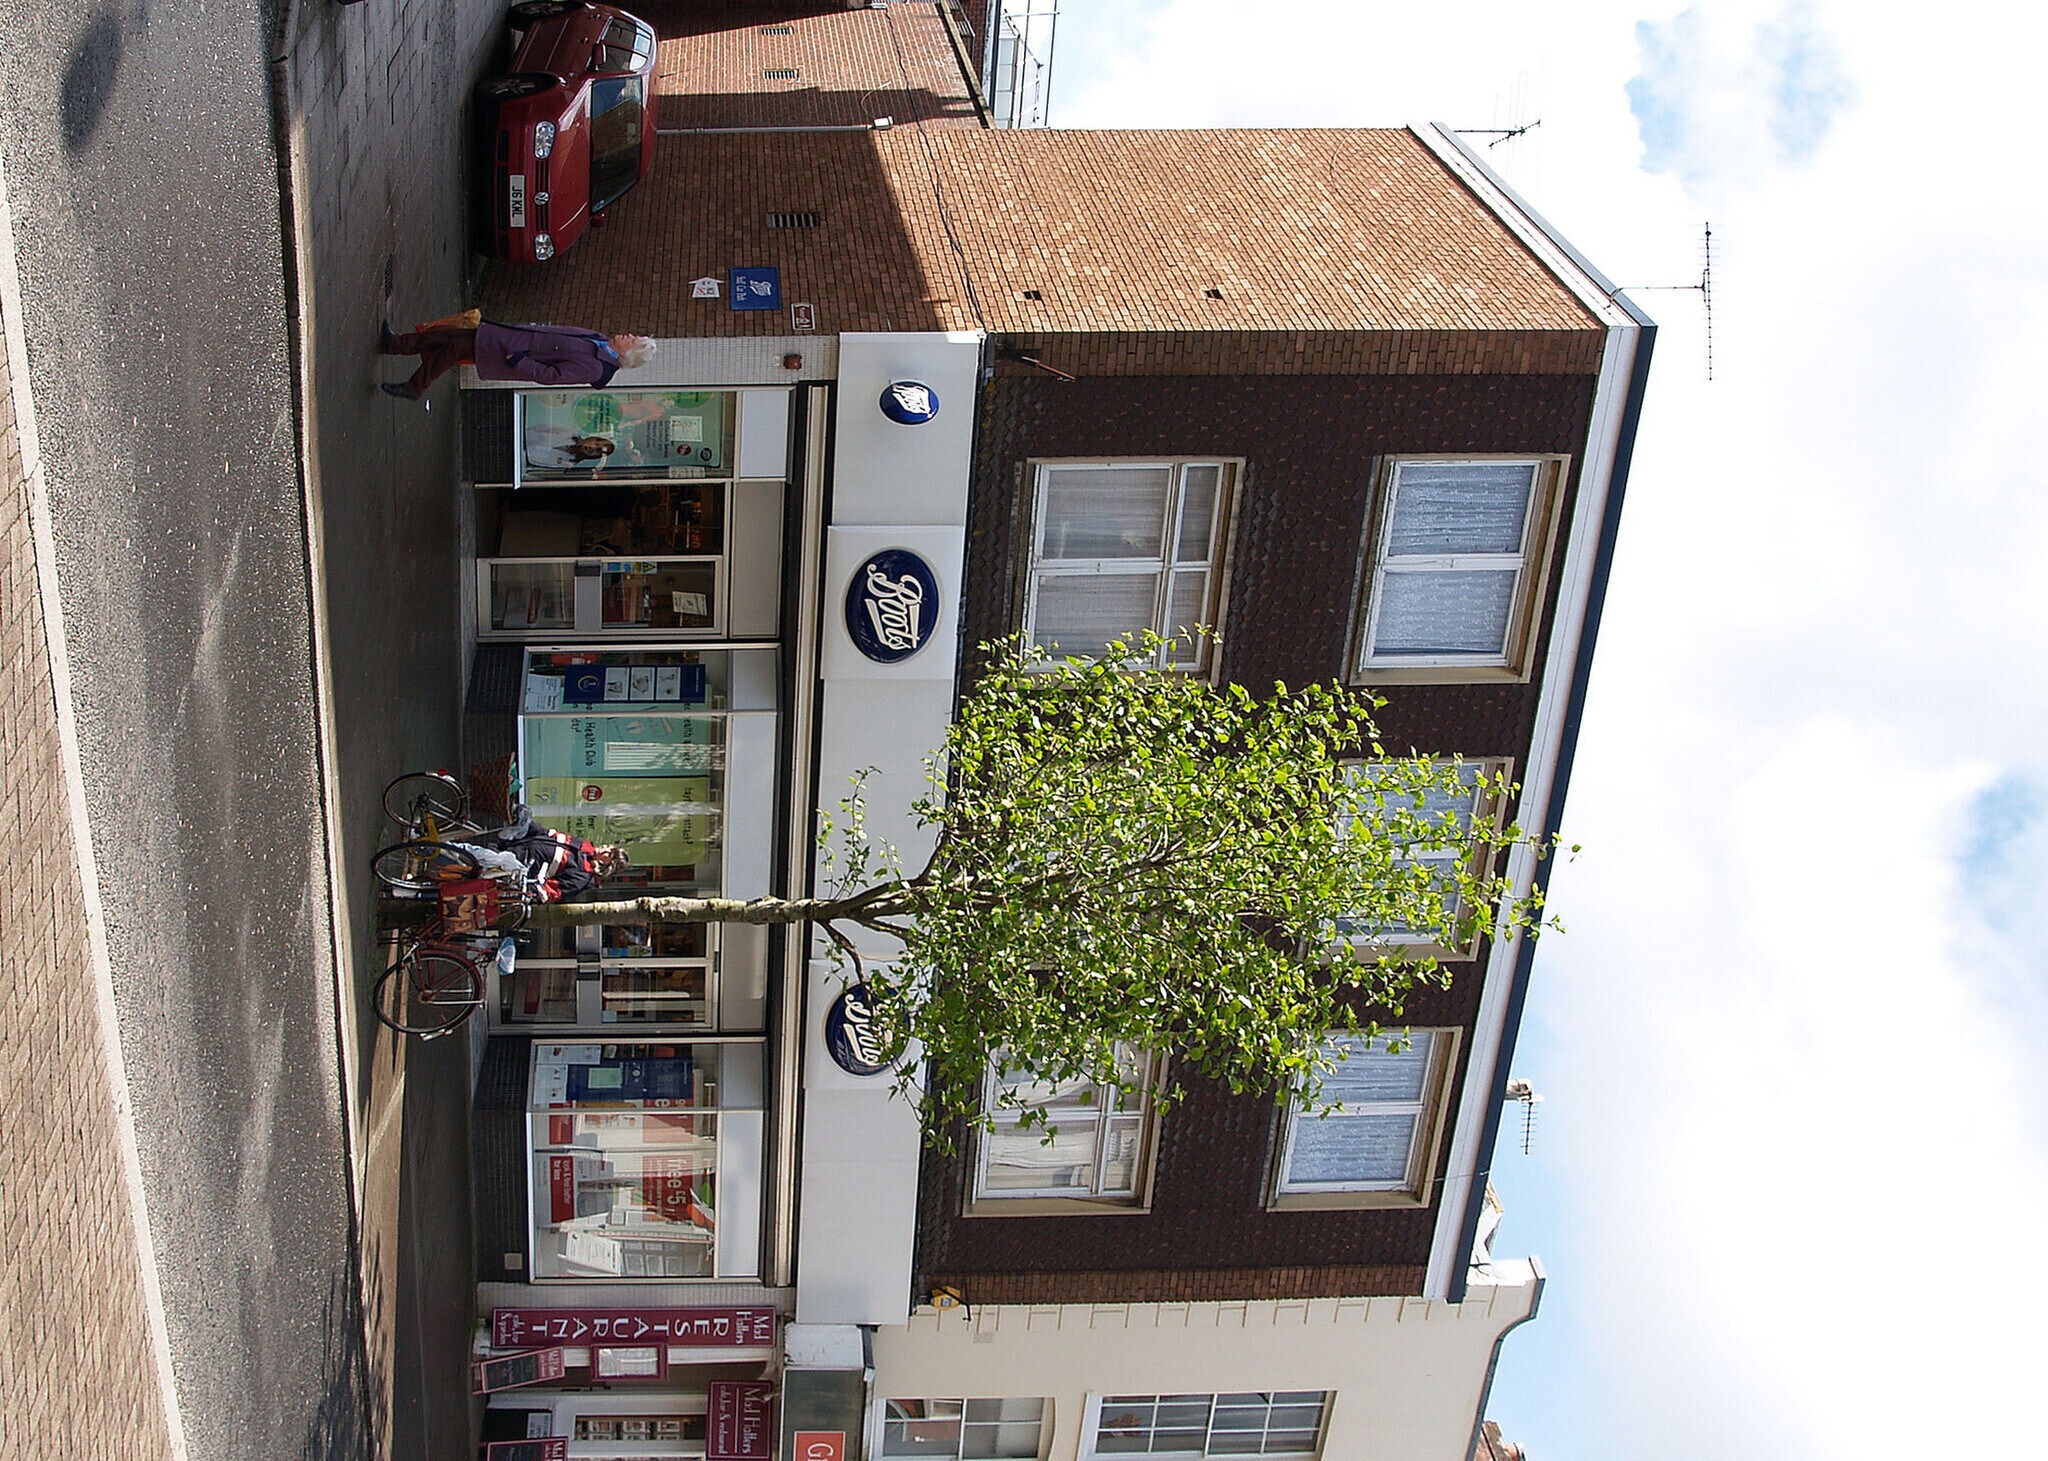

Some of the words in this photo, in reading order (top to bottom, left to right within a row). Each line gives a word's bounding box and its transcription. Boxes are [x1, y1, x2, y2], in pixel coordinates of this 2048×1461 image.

[512, 186, 522, 198] J6
[864, 564, 924, 650] Boots
[584, 722, 596, 748] Health
[585, 750, 596, 766] Club
[666, 1160, 687, 1188] free
[666, 1190, 687, 1204] £5
[500, 1312, 512, 1320] &
[532, 1316, 729, 1339] RESTAURANT
[735, 1311, 752, 1344] Hatters
[754, 1316, 770, 1340] Mad
[744, 1388, 761, 1413] Mad
[718, 1422, 728, 1454] restaurant
[742, 1417, 761, 1454] Hatters
